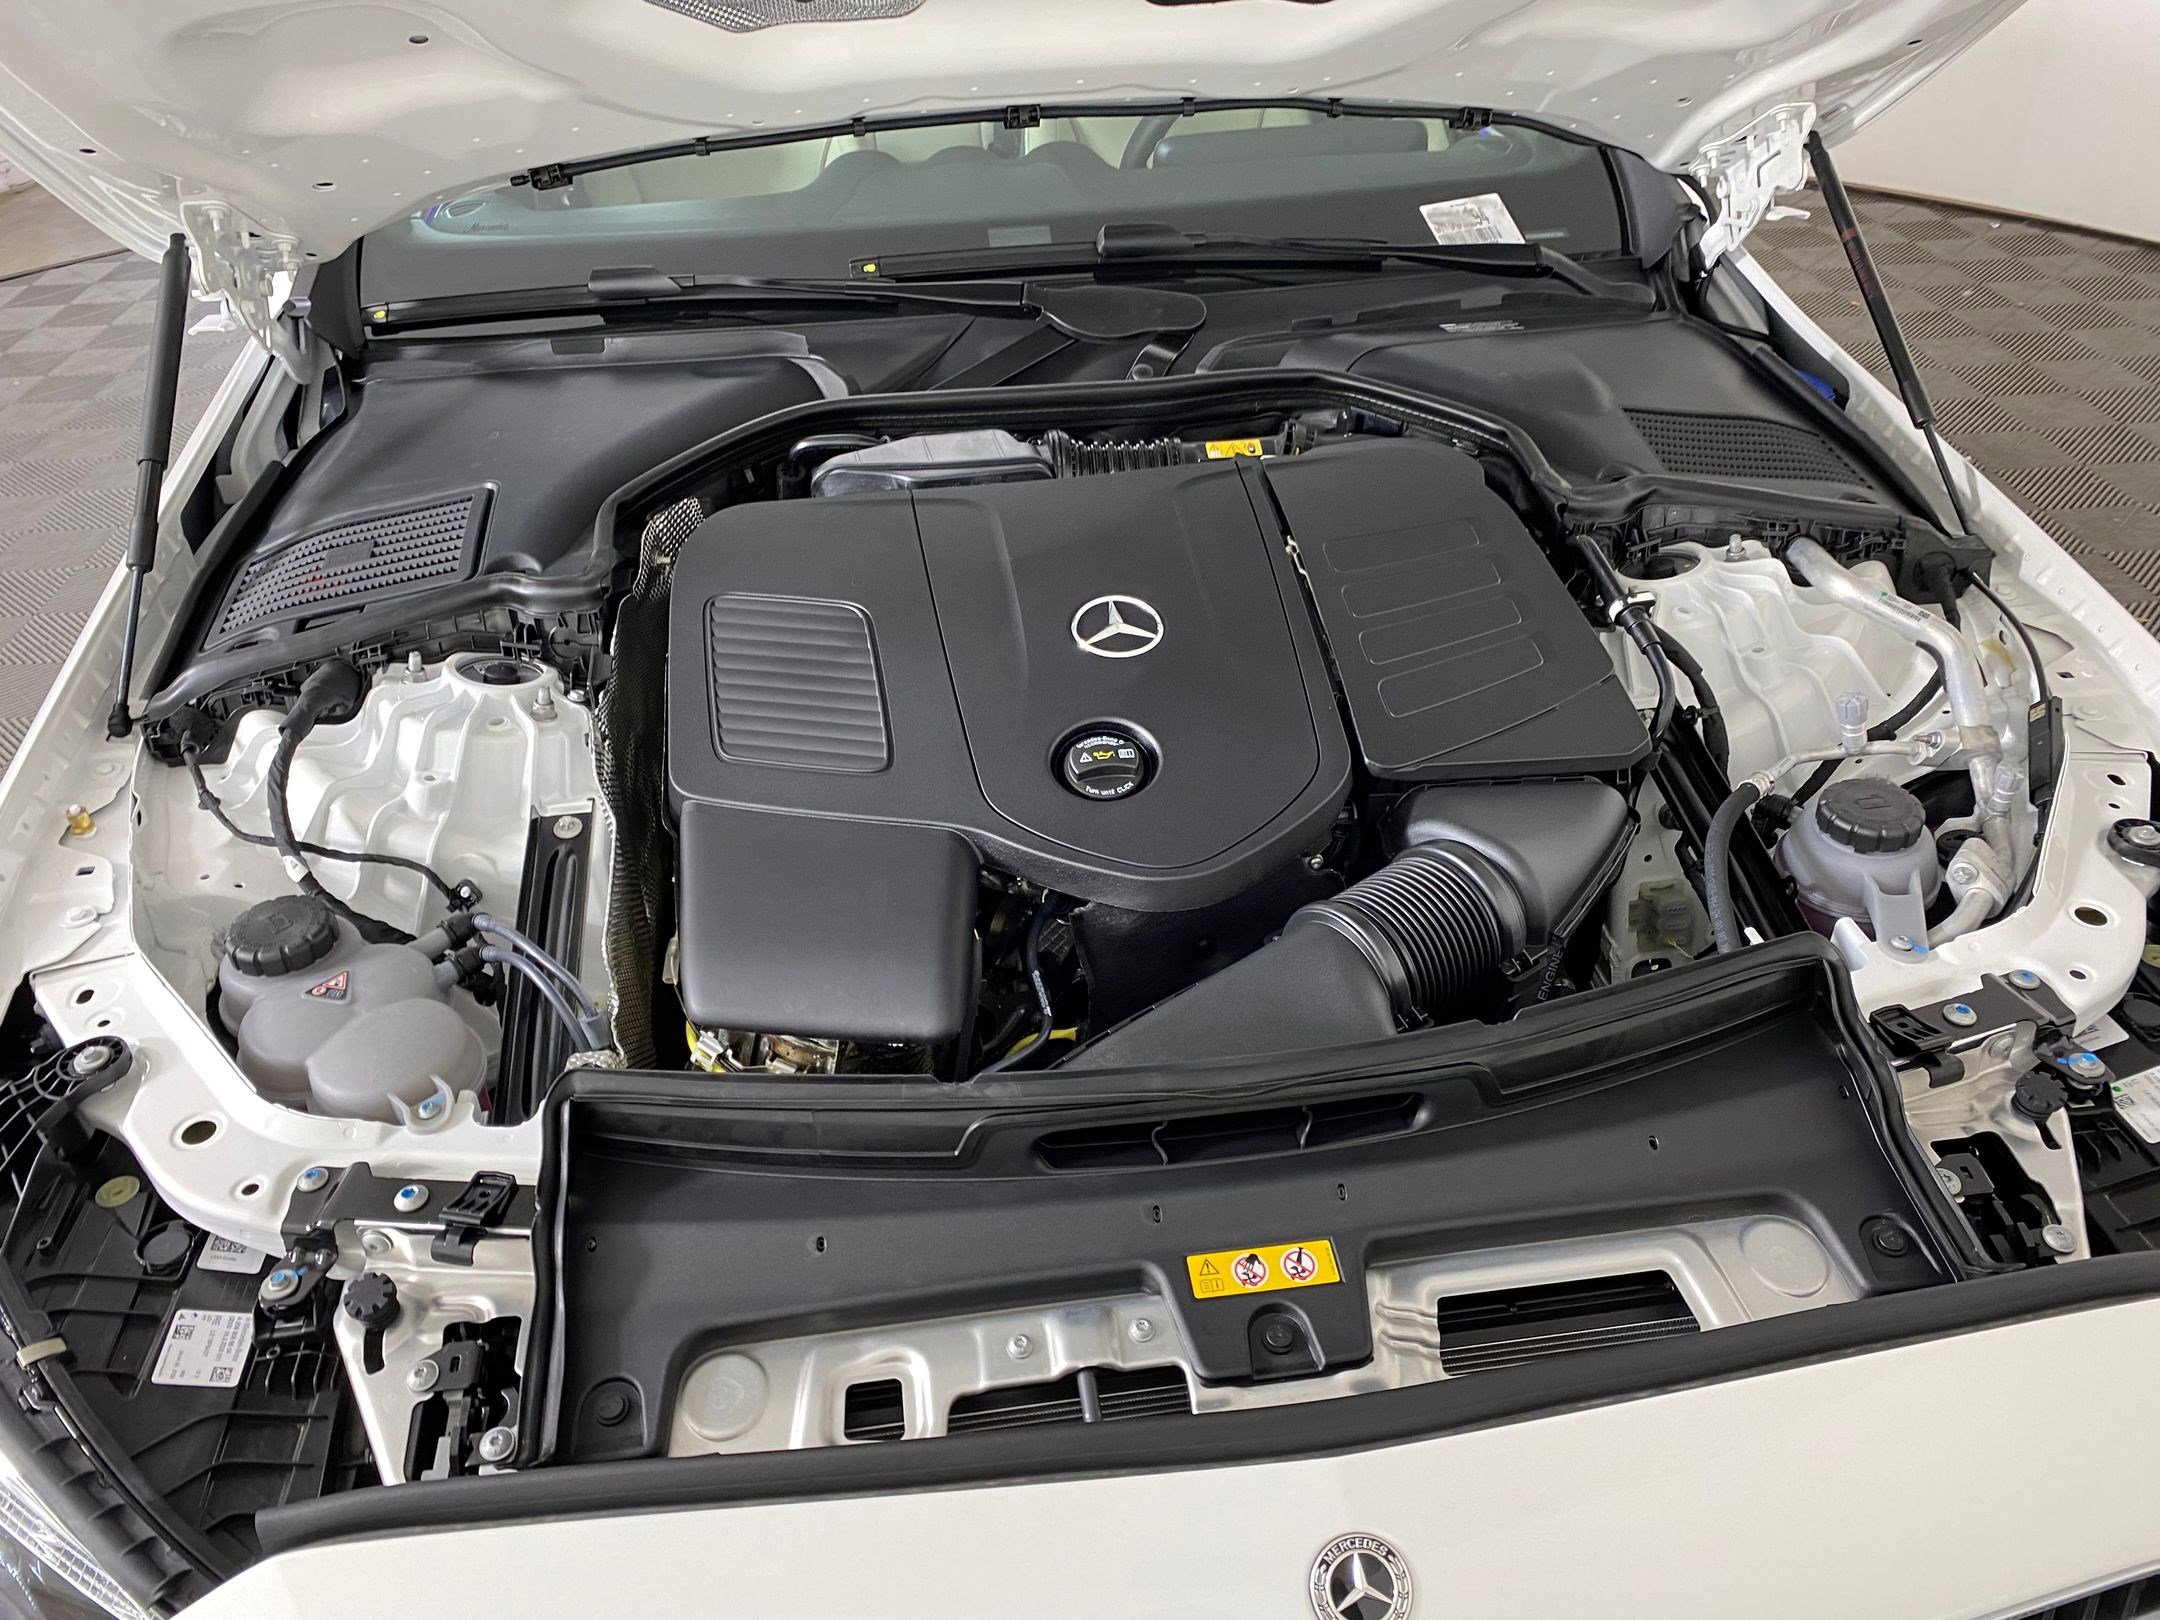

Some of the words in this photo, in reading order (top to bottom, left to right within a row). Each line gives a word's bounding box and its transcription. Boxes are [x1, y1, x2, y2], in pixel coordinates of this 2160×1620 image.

[1085, 785, 1100, 795] Turn
[1116, 781, 1135, 794] CLICK
[1322, 1537, 1389, 1565] MERCEDES
